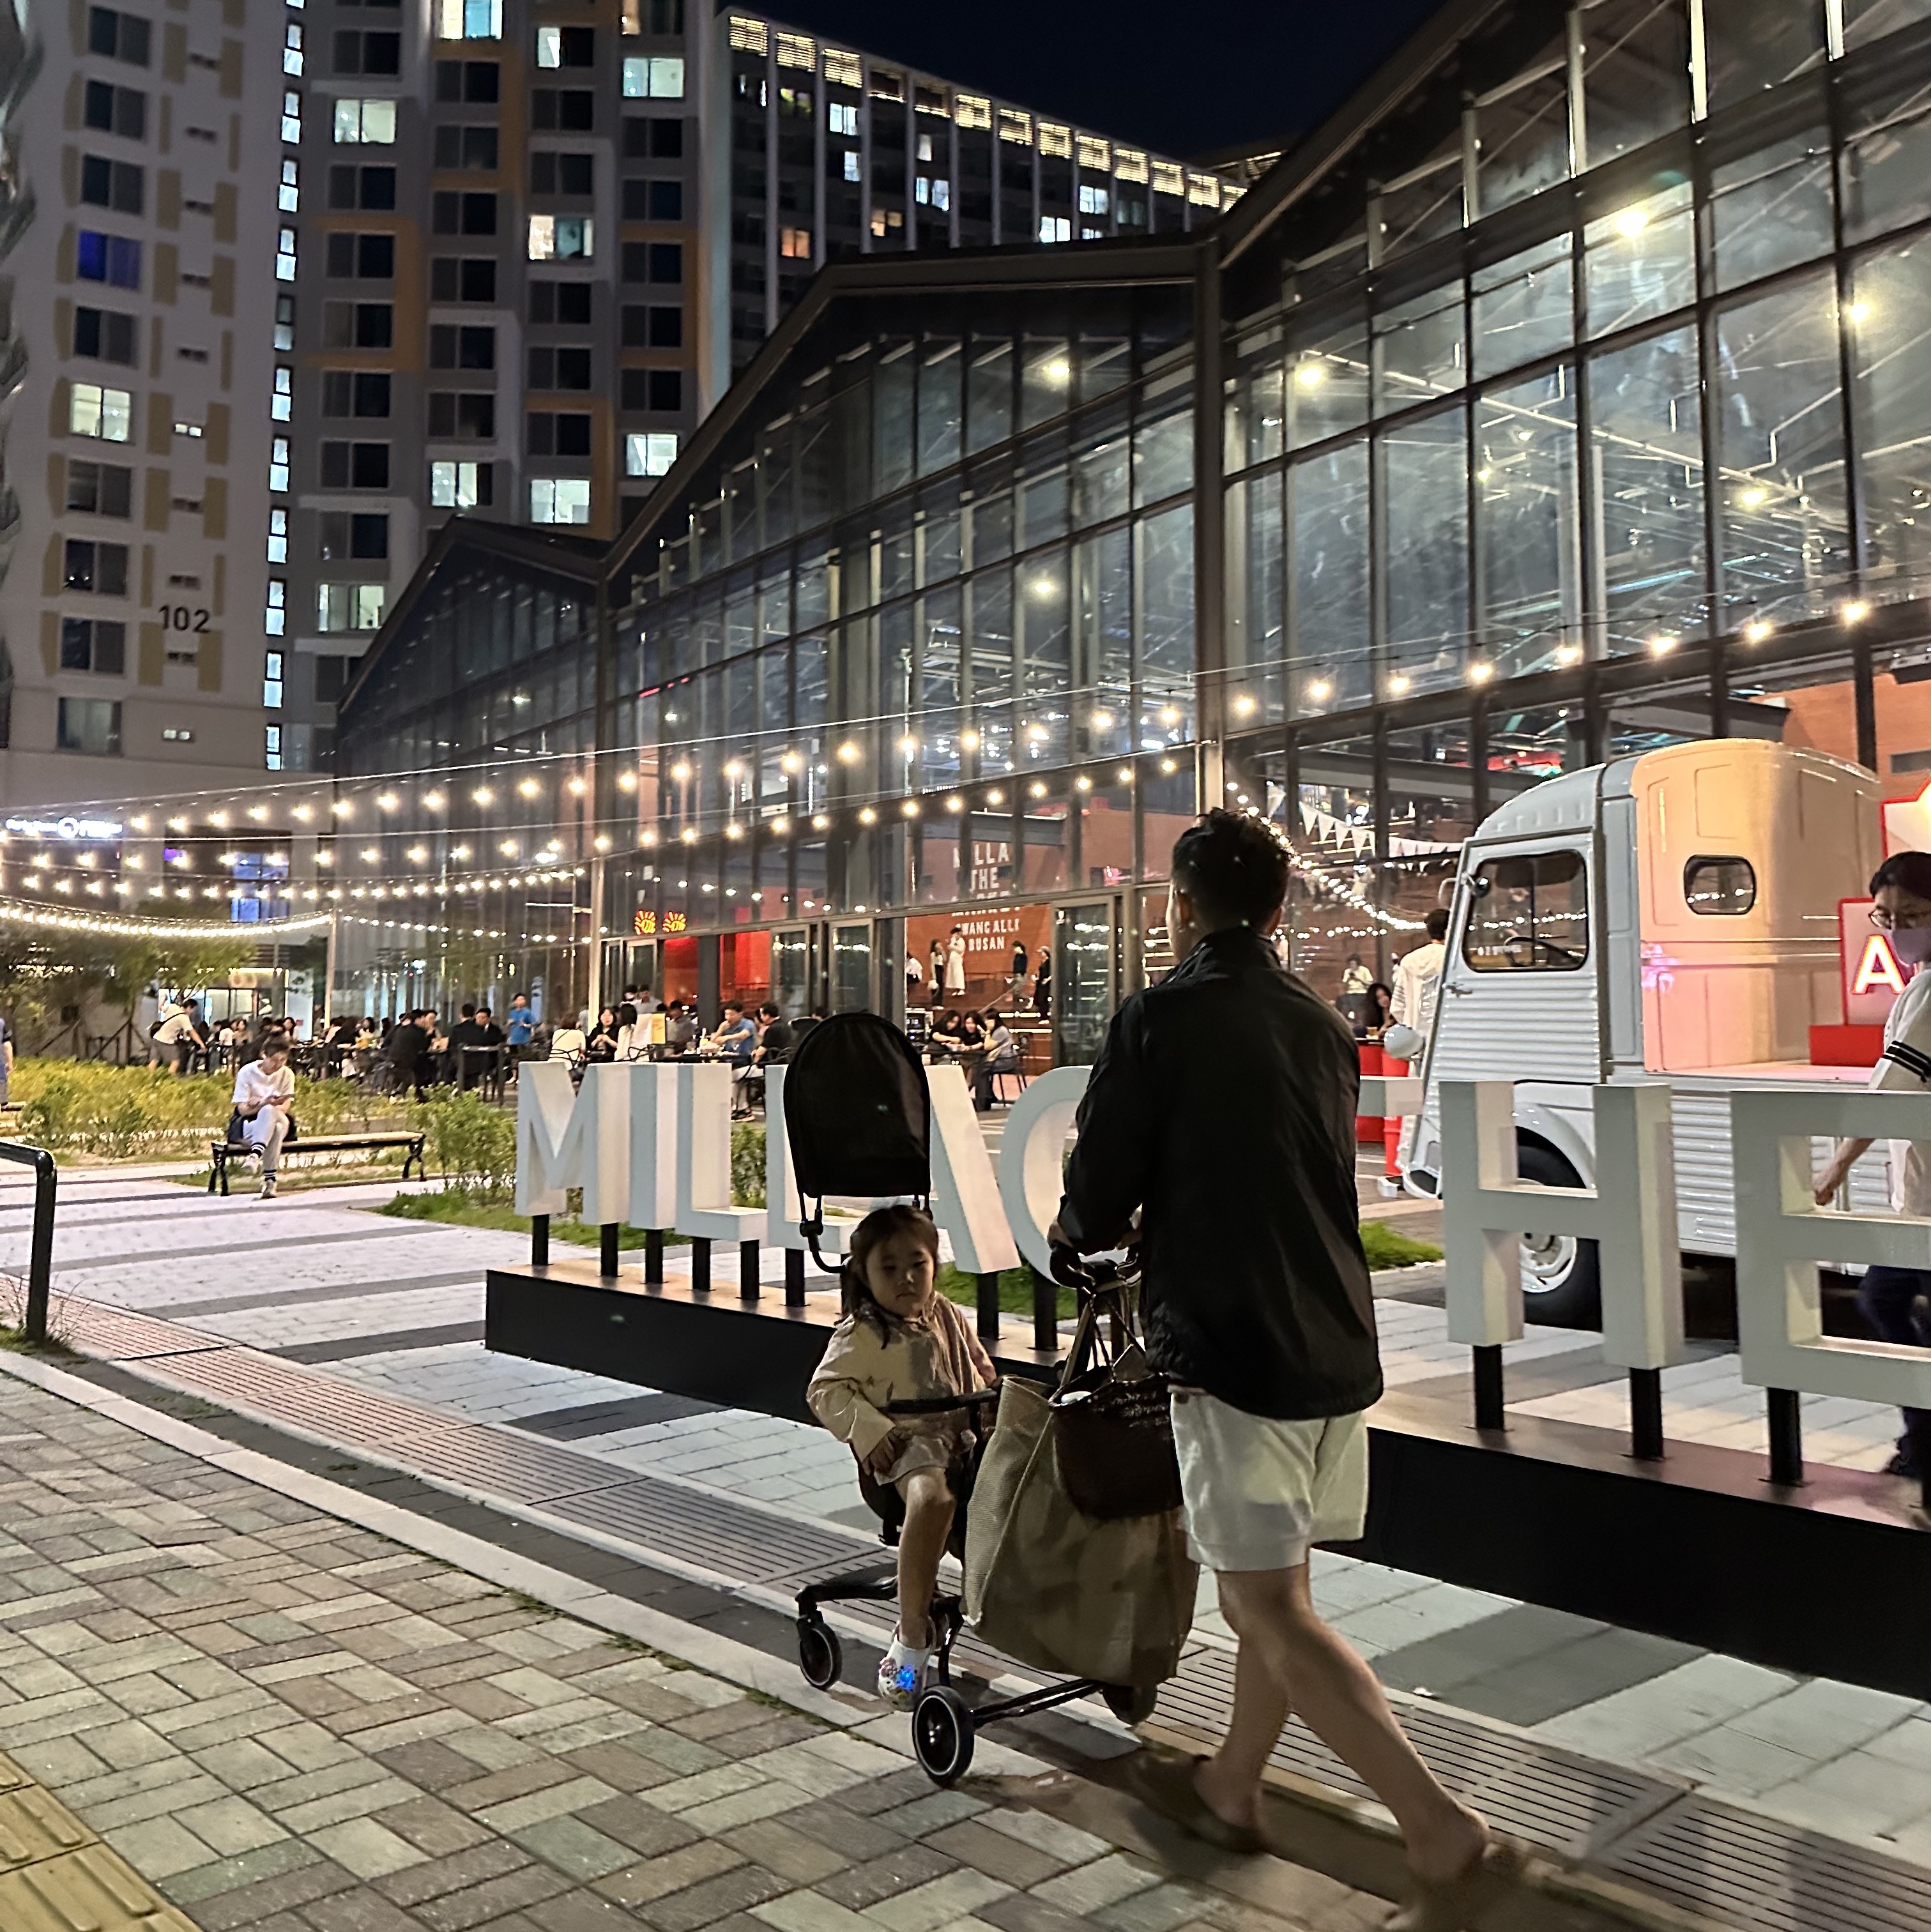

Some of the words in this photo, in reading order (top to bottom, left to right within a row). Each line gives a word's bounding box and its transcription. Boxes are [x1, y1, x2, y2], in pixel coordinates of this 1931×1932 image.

[158, 604, 210, 634] 102
[956, 918, 1019, 936] WANGALLI
[968, 936, 1005, 952] BUSAN
[1357, 1076, 1931, 1408] HE
